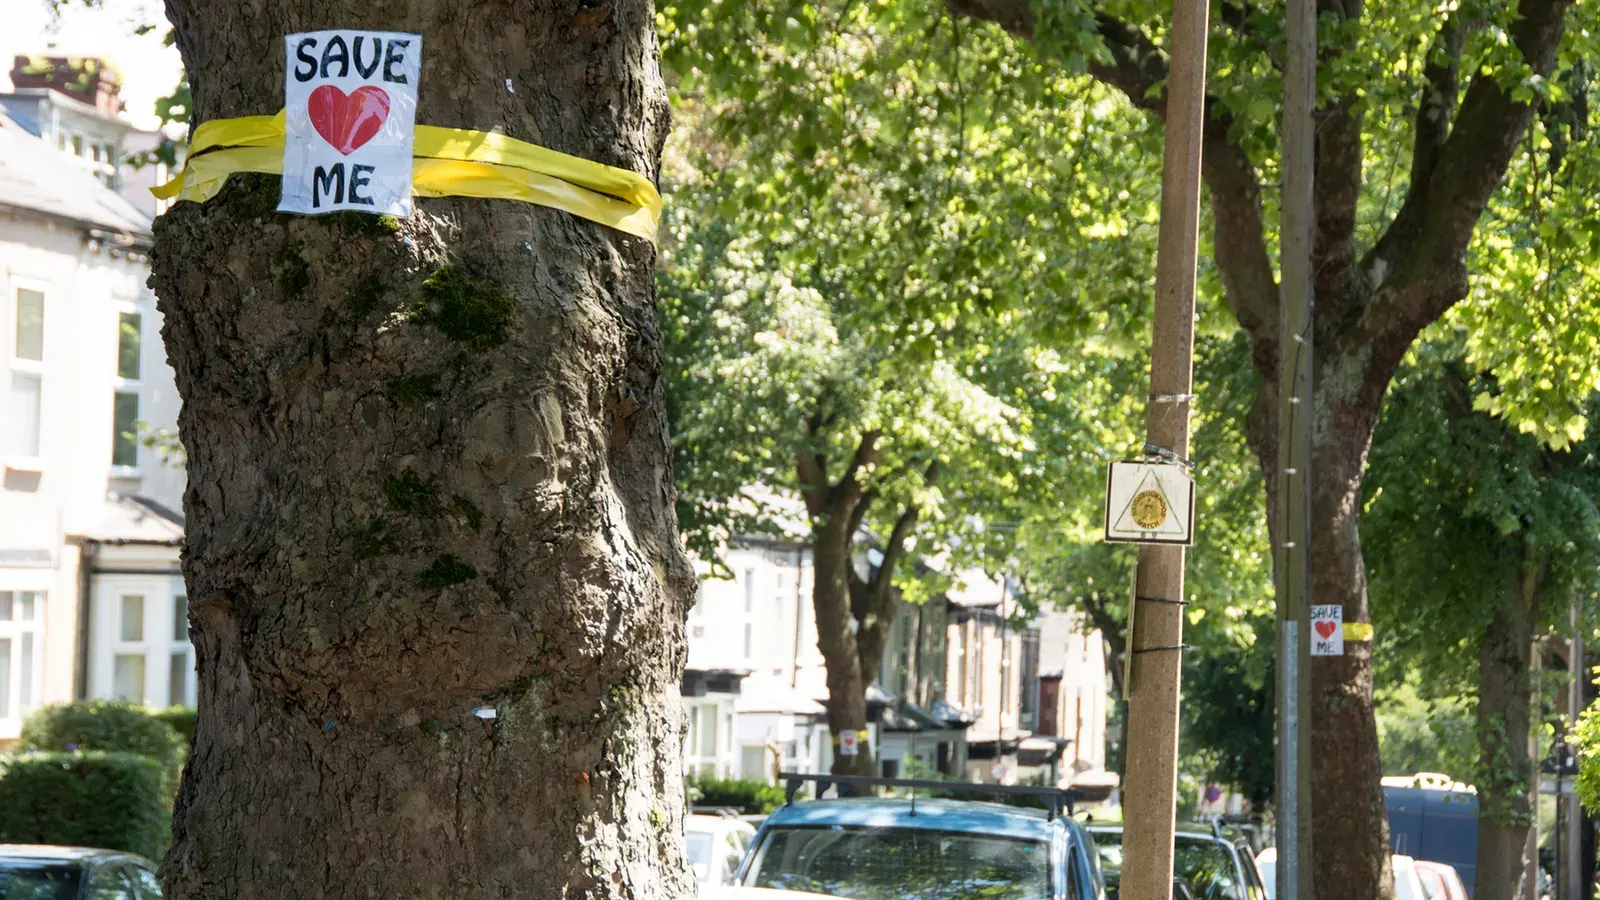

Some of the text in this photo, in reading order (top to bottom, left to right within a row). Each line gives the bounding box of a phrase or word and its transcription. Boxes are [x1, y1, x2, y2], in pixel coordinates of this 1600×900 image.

[294, 35, 411, 84] SAVE
[313, 162, 375, 208] ME
[1137, 519, 1160, 529] WATCH
[1311, 606, 1339, 619] SAVE
[1316, 641, 1336, 653] ME
